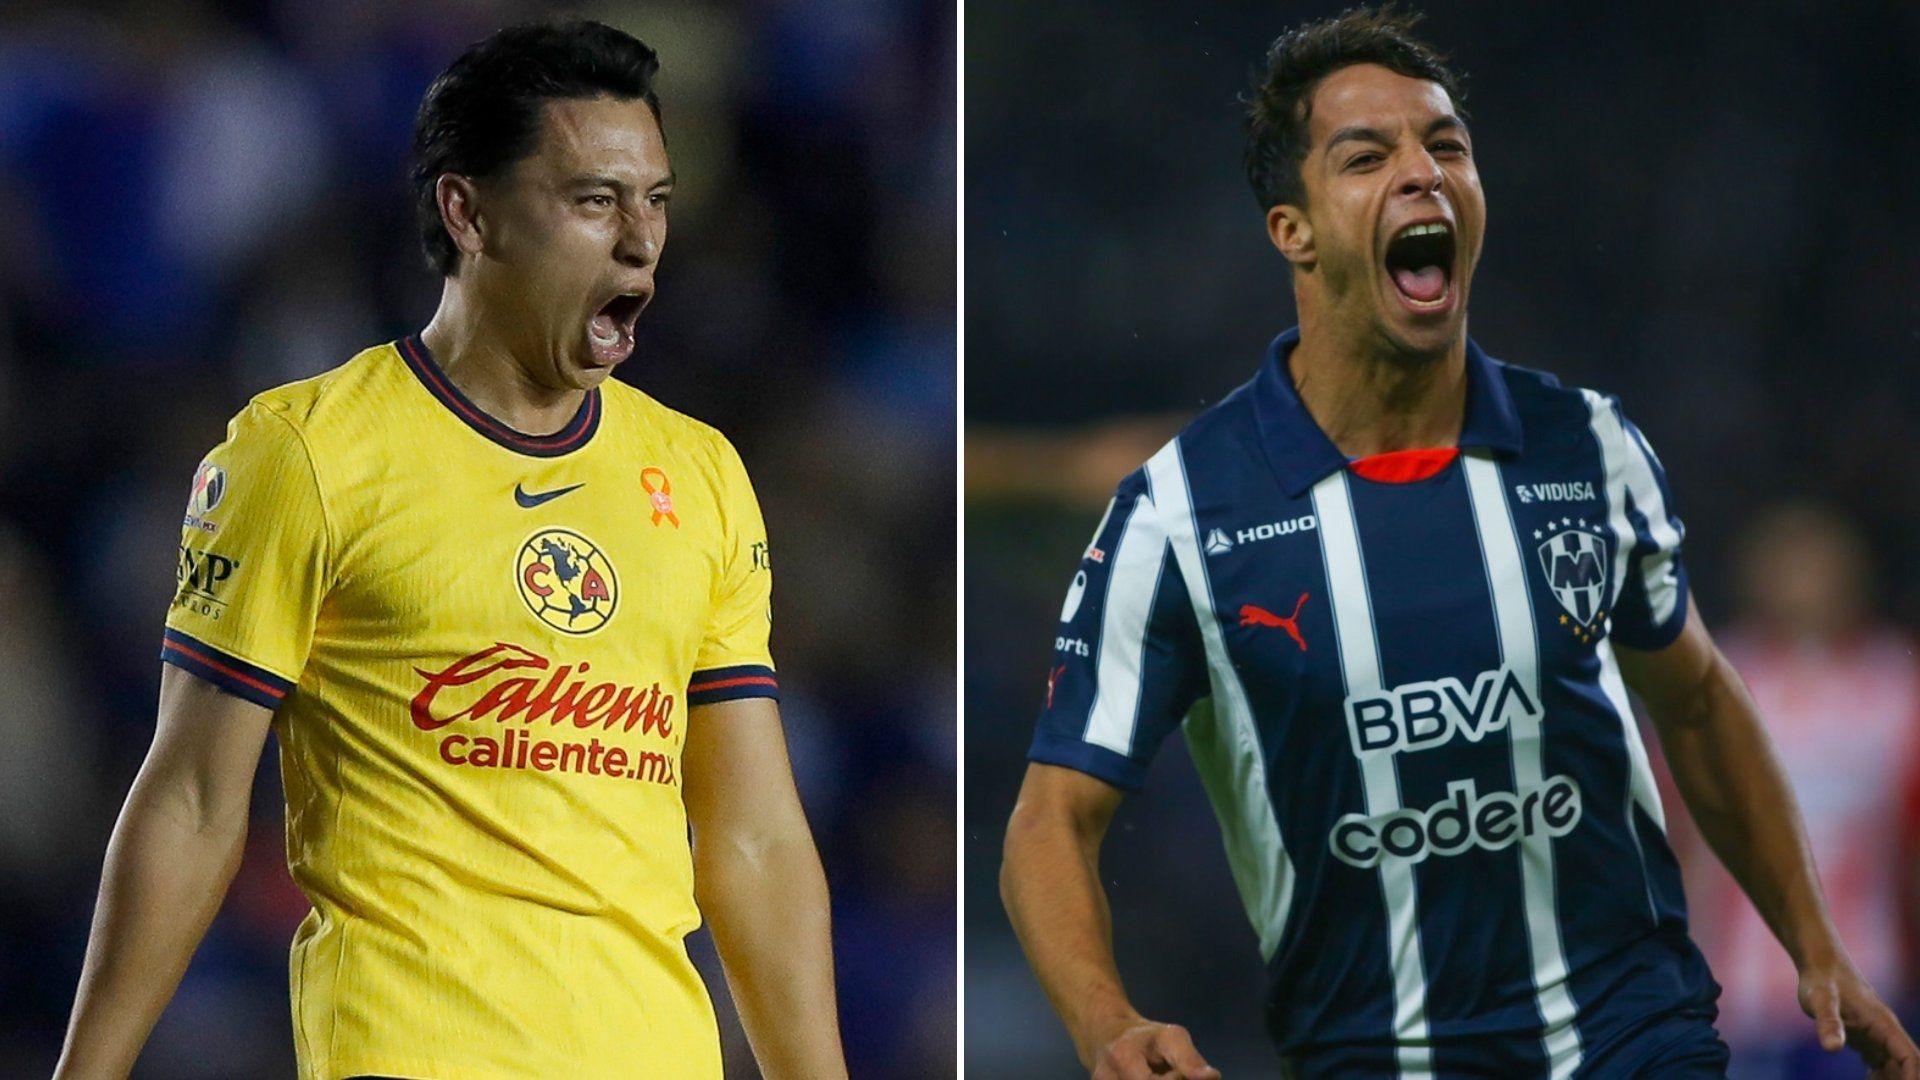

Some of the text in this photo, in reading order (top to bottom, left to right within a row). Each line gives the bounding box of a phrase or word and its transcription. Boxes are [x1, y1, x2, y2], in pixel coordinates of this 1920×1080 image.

[1531, 481, 1596, 502] VIDUSA
[1236, 514, 1317, 545] HOWO
[524, 562, 610, 602] C A
[1055, 635, 1090, 657] orts
[409, 642, 674, 740] Caliente
[1351, 669, 1538, 752] BBVA
[438, 728, 678, 788] caliente.mx
[1334, 780, 1578, 863] codere
